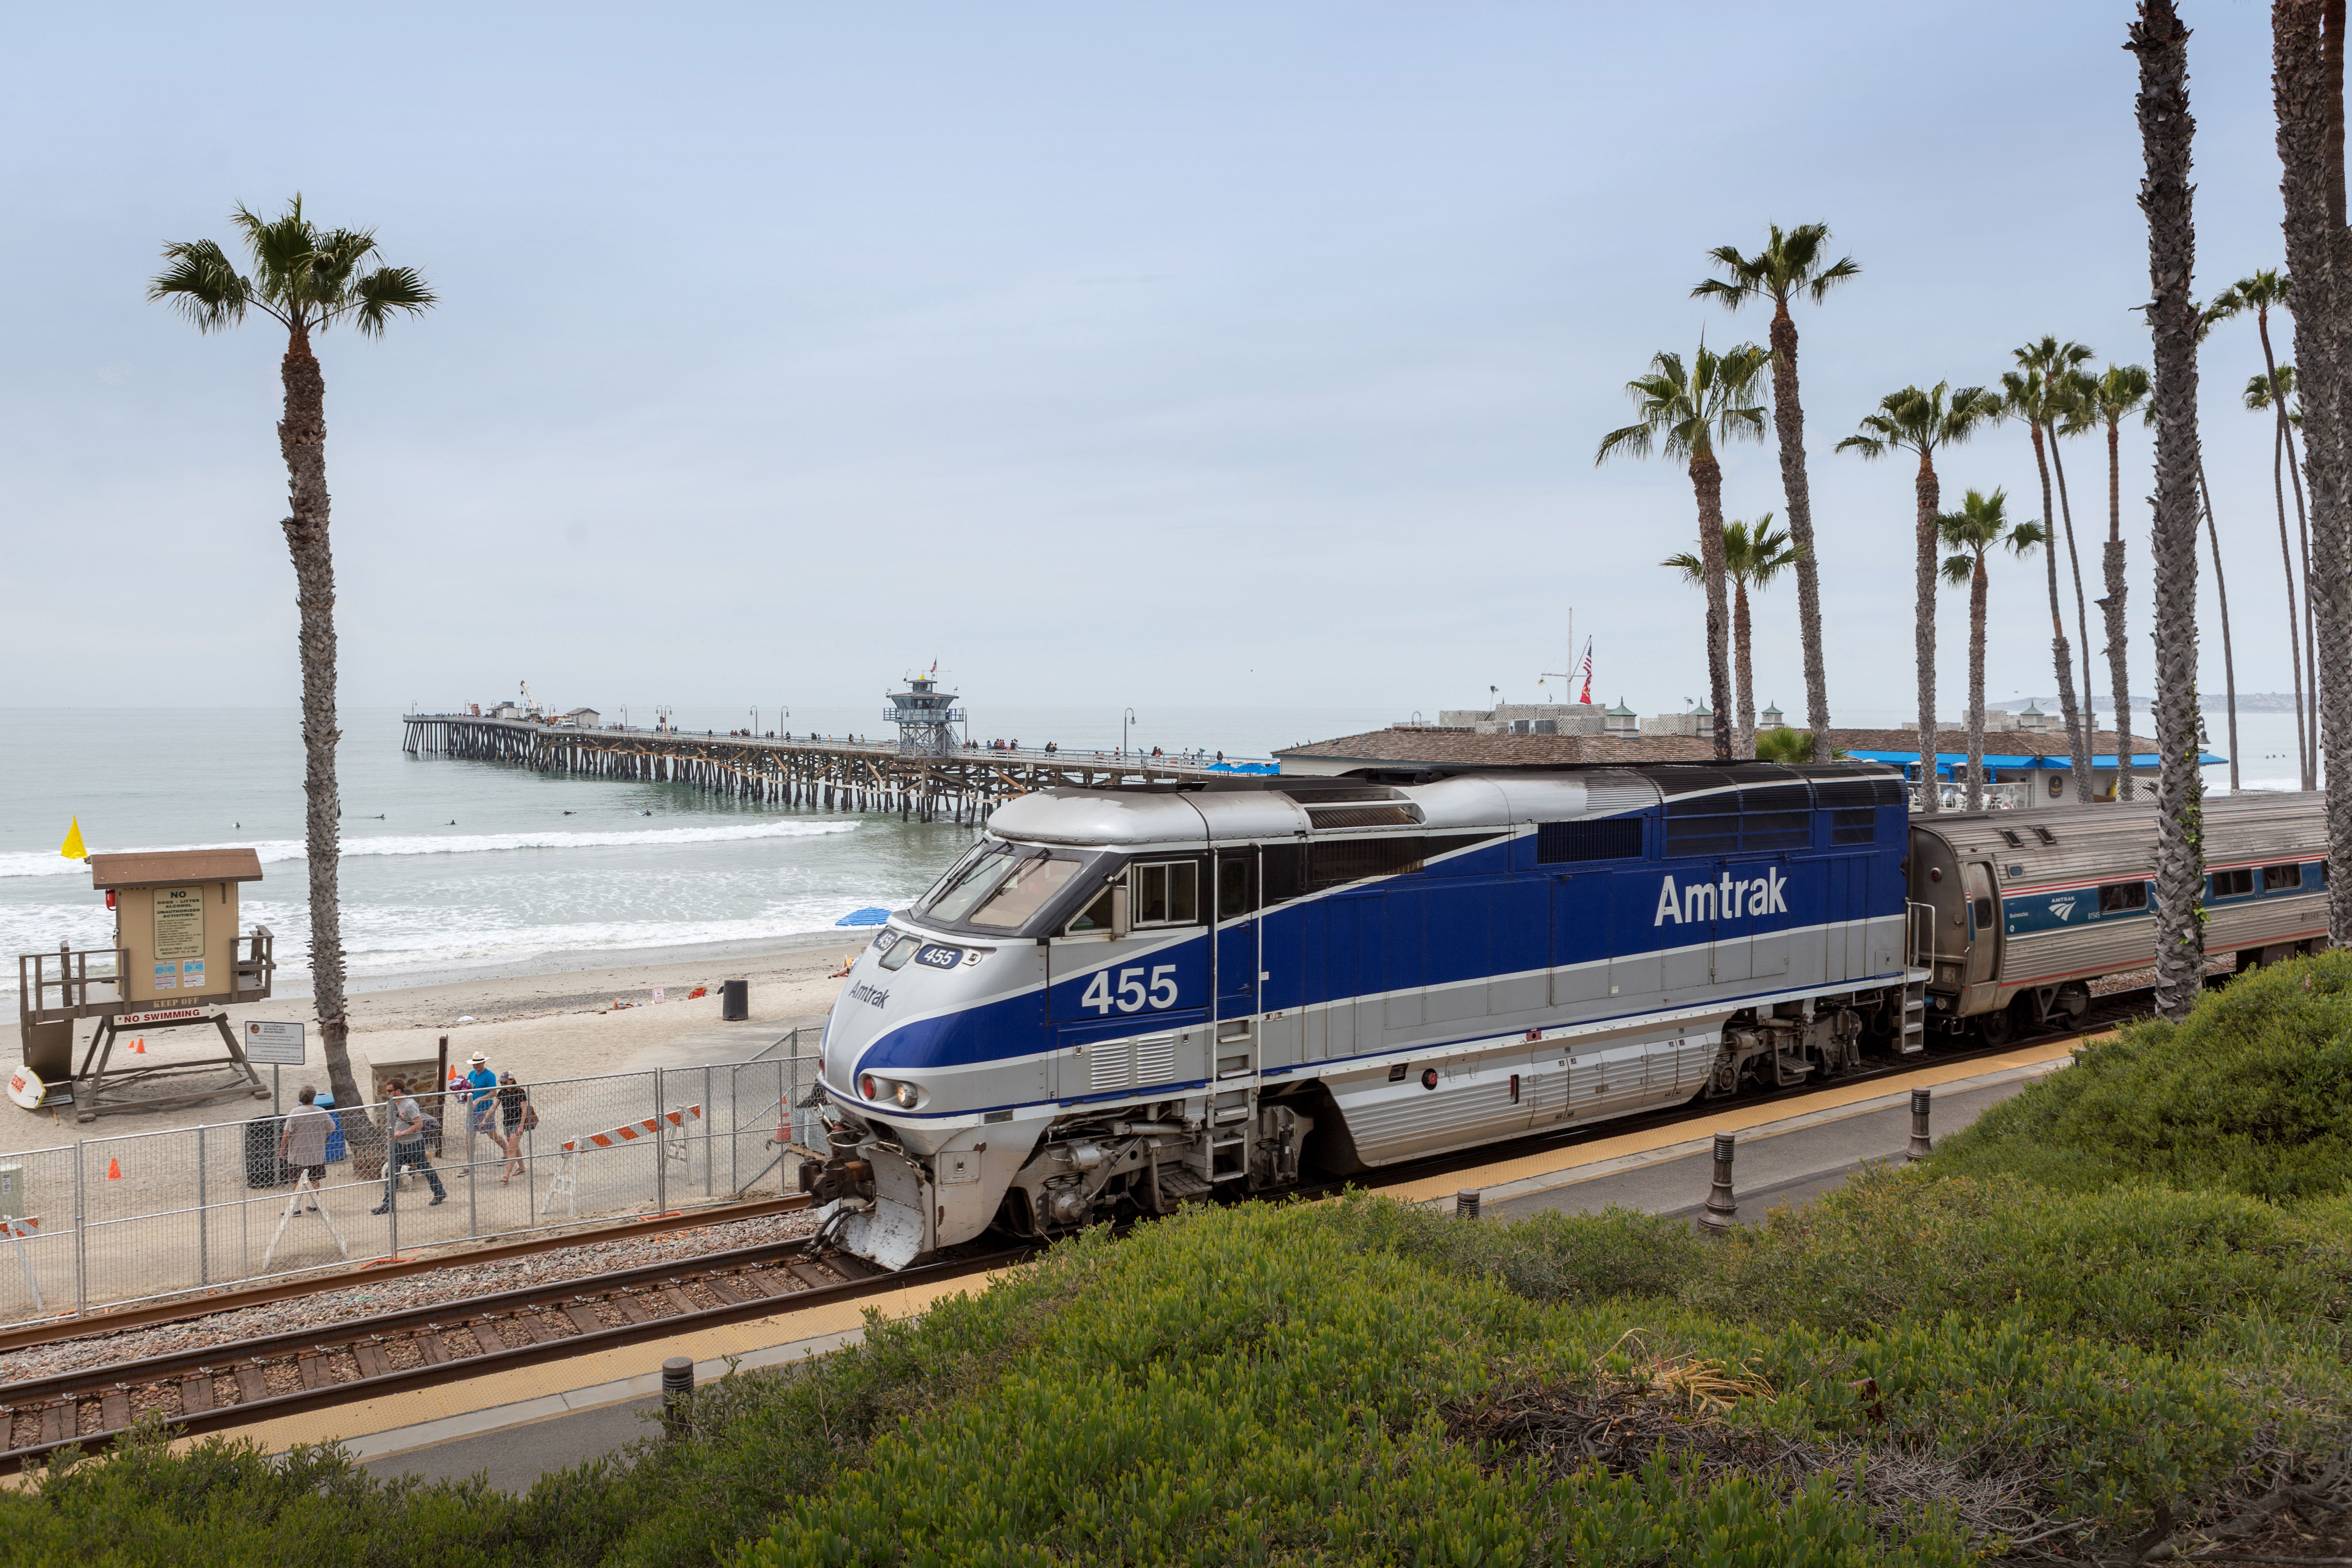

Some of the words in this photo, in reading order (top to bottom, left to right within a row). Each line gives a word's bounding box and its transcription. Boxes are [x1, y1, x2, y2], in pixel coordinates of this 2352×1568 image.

[1654, 866, 1788, 927] Amtrak
[878, 933, 894, 949] 455
[924, 948, 956, 965] 455
[848, 980, 890, 1009] Amtrak
[1082, 964, 1178, 1014] 455
[153, 999, 178, 1008] KEEP
[144, 1009, 200, 1021] SWIMMING
[10, 1074, 26, 1093] RESCUE
[1050, 1091, 1055, 1099] F
